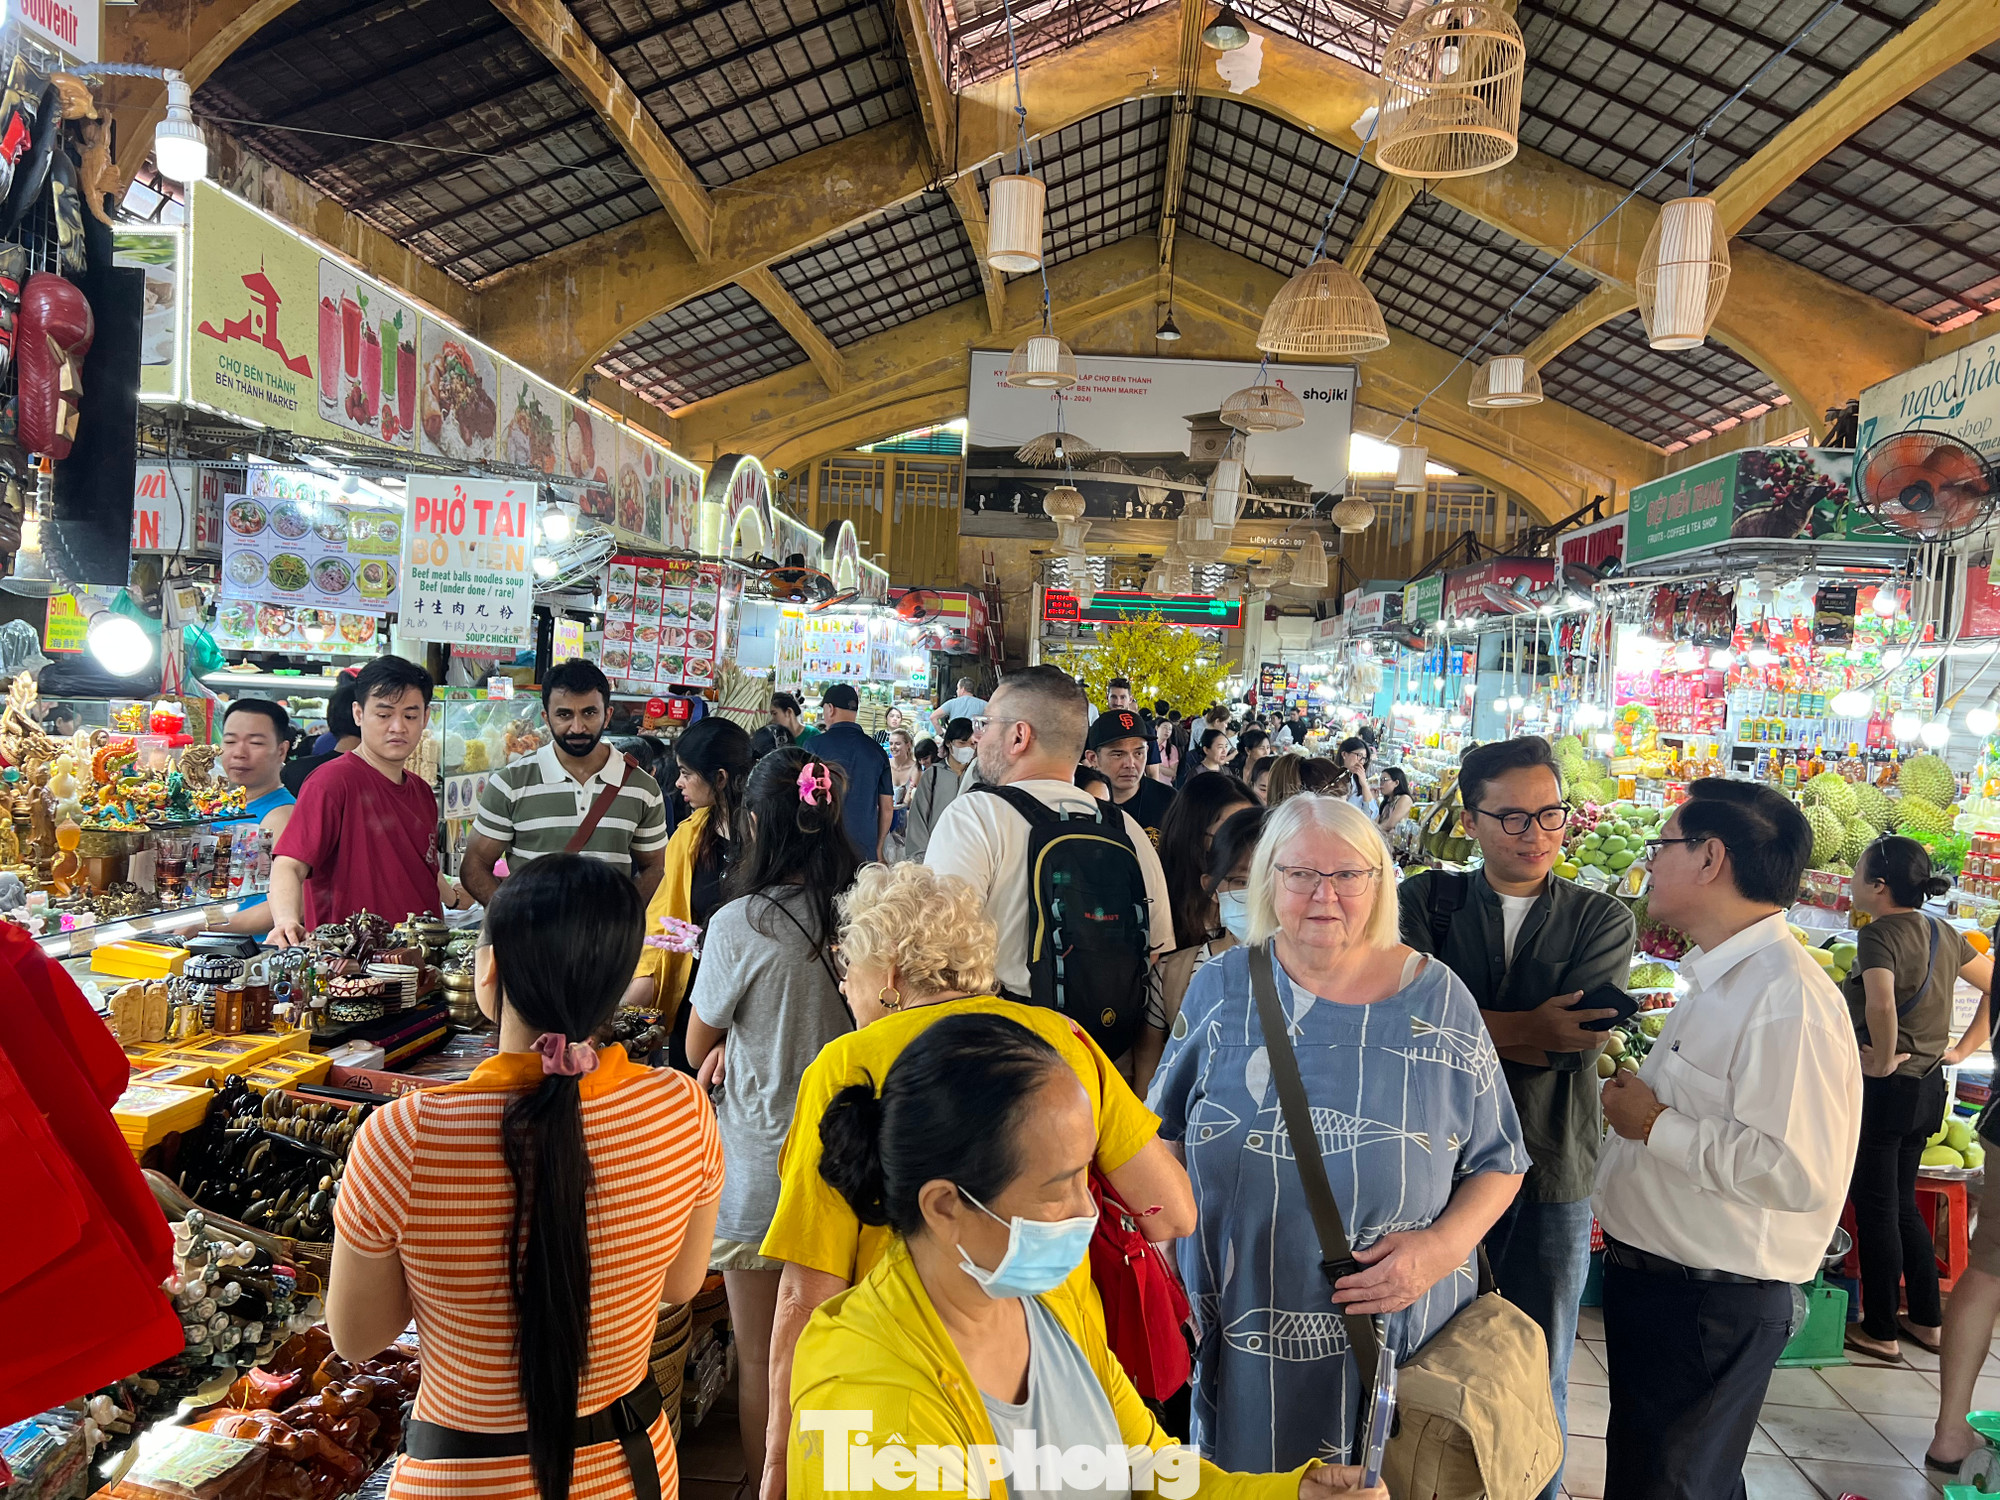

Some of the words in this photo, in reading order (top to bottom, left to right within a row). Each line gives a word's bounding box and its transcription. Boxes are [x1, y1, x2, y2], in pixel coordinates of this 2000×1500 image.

[218, 355, 242, 374] CHỢ
[266, 372, 296, 396] THÀNH
[1094, 374, 1110, 383] CHỢ
[1128, 375, 1152, 384] THÀNH
[236, 378, 264, 399] THÀNH
[266, 392, 298, 412] MARKET
[1118, 387, 1148, 396] MARKET
[1302, 388, 1348, 403] shojiki
[1958, 416, 1992, 438] shop
[414, 484, 467, 536] PHỞ
[473, 490, 526, 538] TÁI
[1666, 525, 1686, 539] COFFEE
[1691, 521, 1702, 532] TEA
[1702, 516, 1718, 530] SHOP
[412, 533, 449, 567] BÒ
[458, 535, 525, 572] VIÊN
[412, 567, 430, 579] Beef
[432, 571, 451, 581] meat
[452, 570, 472, 583] balls
[474, 572, 503, 585] noodles
[506, 577, 524, 588] soup
[420, 580, 438, 592] Beef
[440, 583, 464, 595] (under
[467, 583, 486, 596] done
[494, 587, 515, 599] rare)
[466, 632, 485, 642] SOUP
